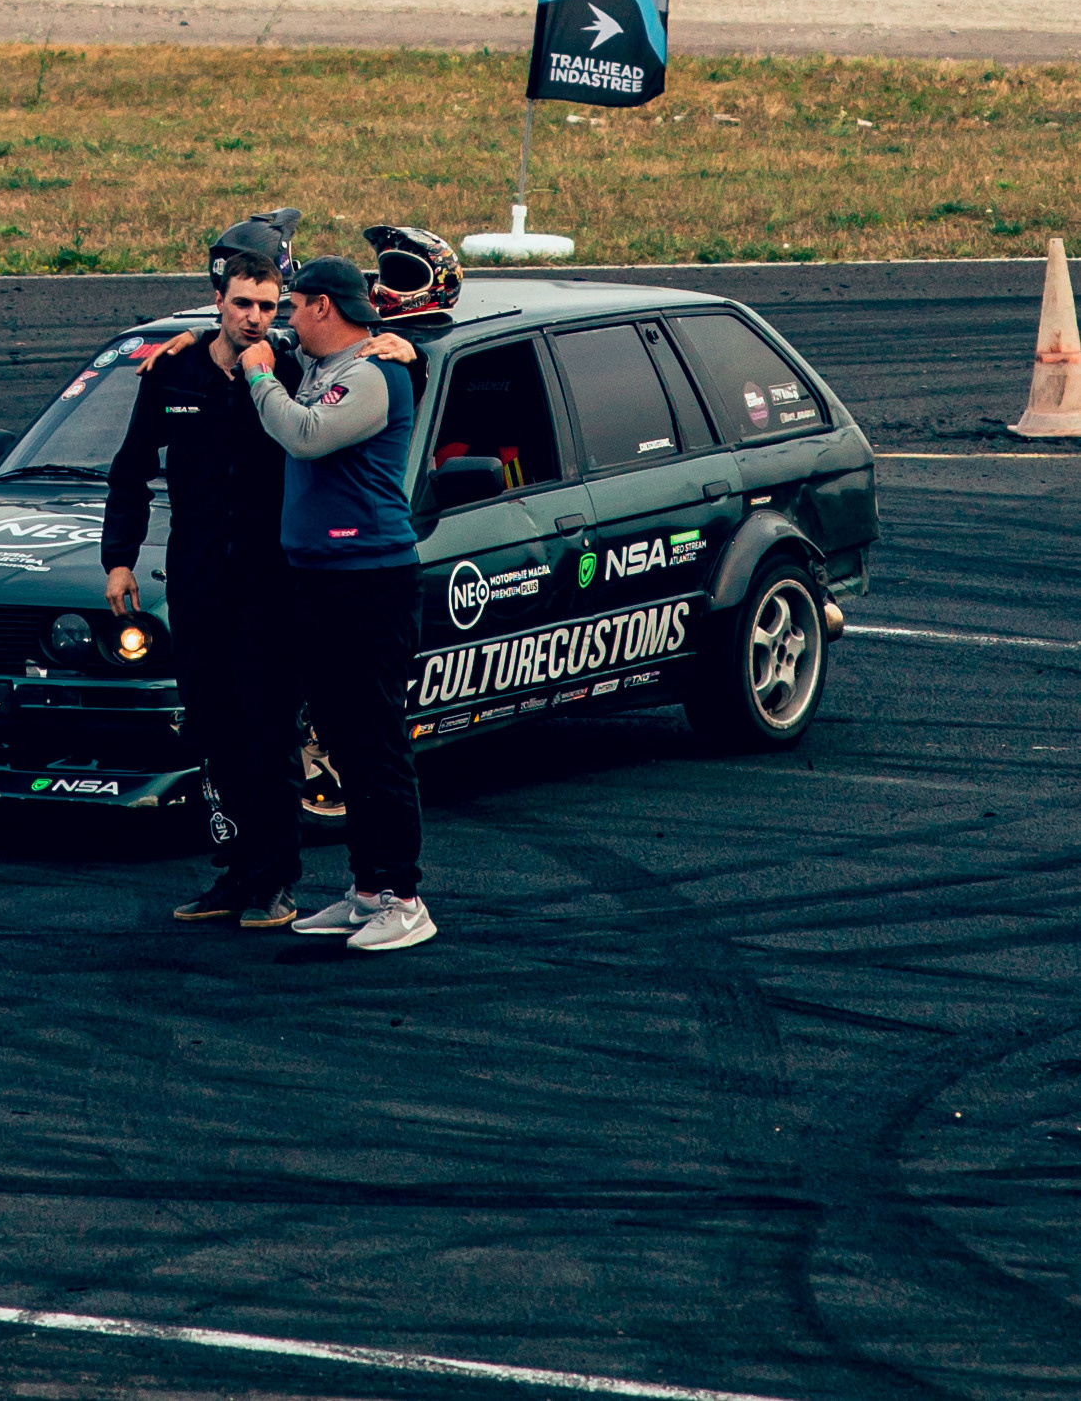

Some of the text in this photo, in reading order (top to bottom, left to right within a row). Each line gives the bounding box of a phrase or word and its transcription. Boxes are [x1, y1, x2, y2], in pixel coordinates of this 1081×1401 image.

[550, 53, 645, 80] TRAILHEAD
[550, 68, 643, 93] INDASTREE
[605, 538, 667, 581] NSA
[454, 579, 490, 610] NEO
[419, 601, 690, 707] CULTURECUSTOMS
[52, 779, 119, 796] NSA
